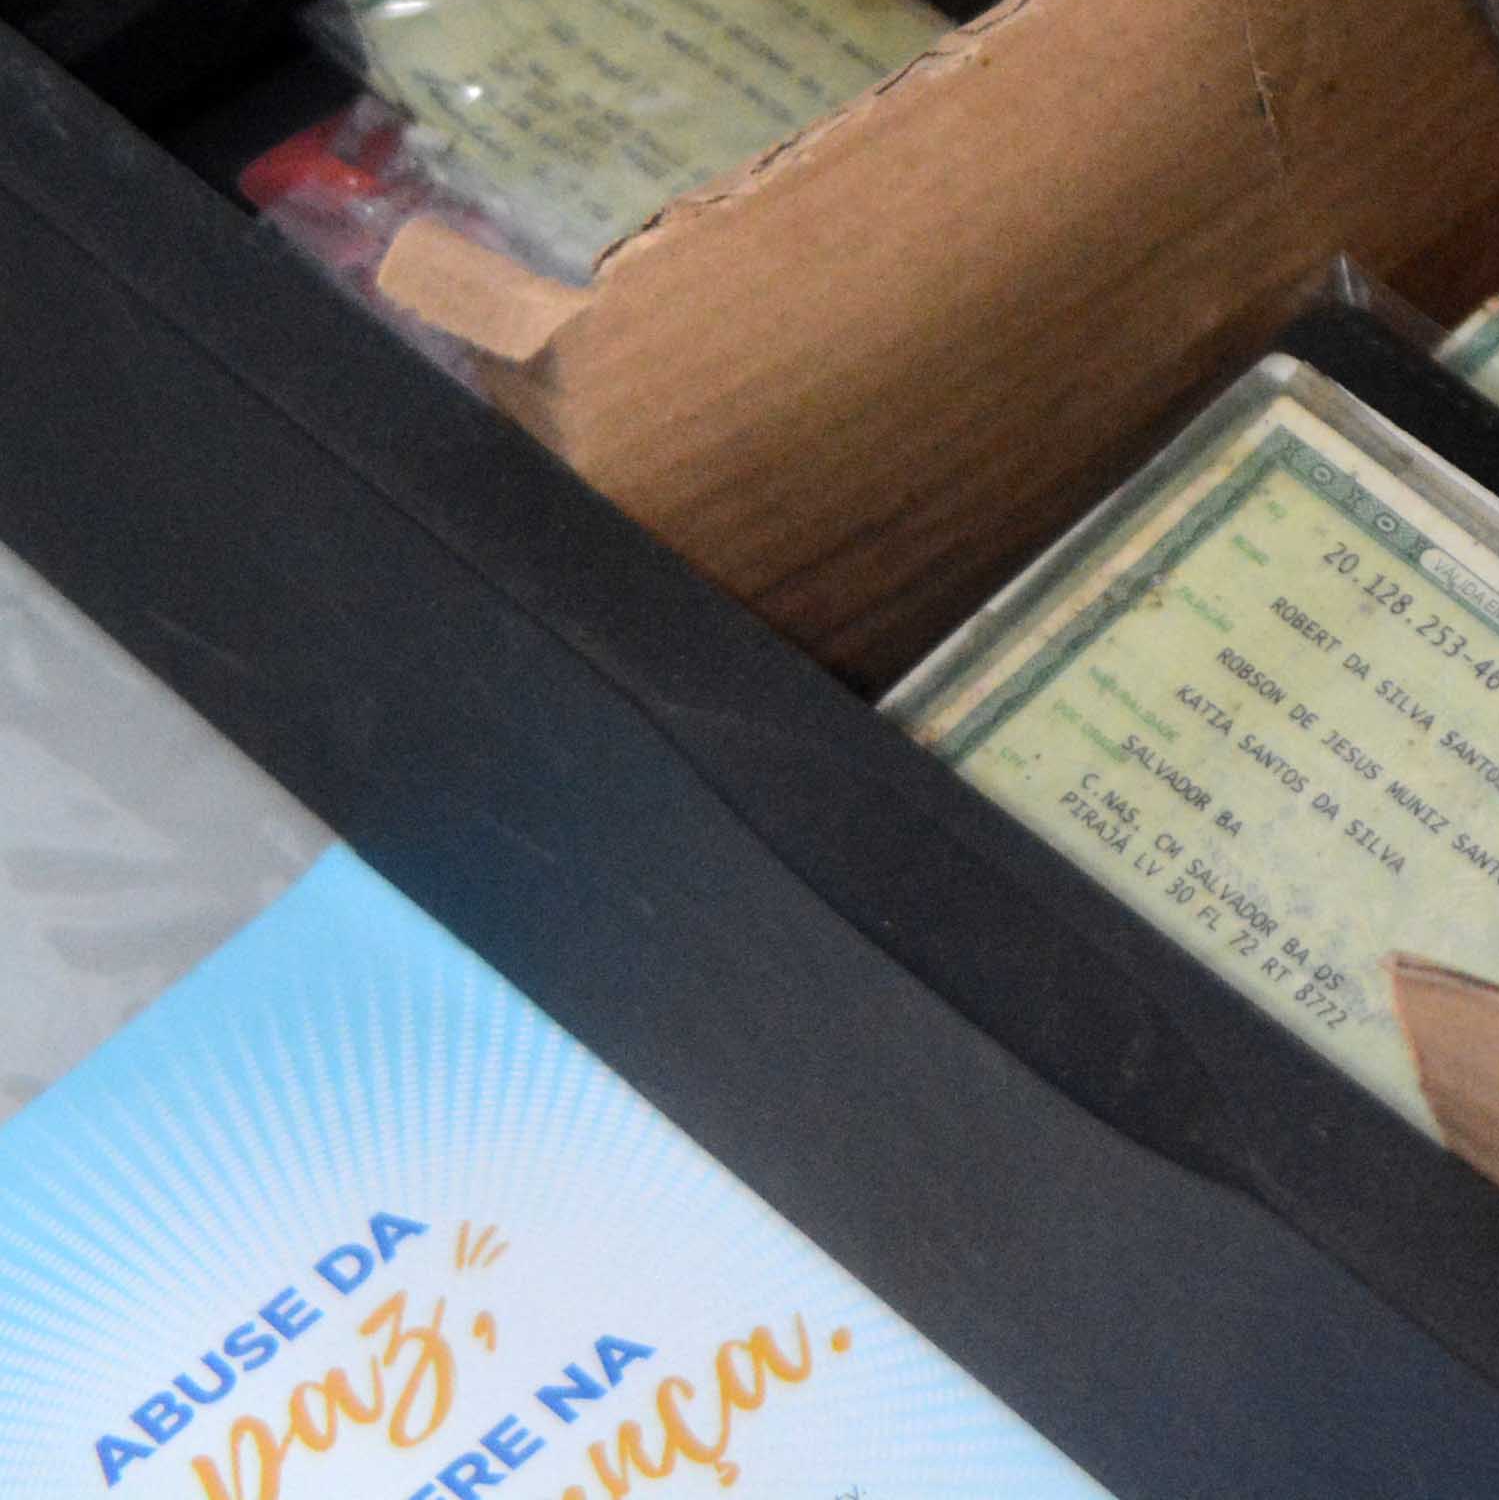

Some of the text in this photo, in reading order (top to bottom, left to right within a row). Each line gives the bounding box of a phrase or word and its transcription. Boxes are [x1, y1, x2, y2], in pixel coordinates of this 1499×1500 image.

[1210, 644, 1292, 708] ROBSON
[1283, 701, 1323, 734] DE
[1314, 726, 1390, 785] JESUS
[1378, 778, 1455, 837] MUNIZ
[1263, 594, 1346, 657] ROBERT
[1337, 649, 1379, 683] DA
[1368, 675, 1445, 734] SILVA
[1112, 731, 1249, 838] SALVADOR BA
[1169, 681, 1415, 875] KATIA SANTOS DA SILVA
[1128, 850, 1166, 881] LV
[1161, 874, 1202, 908] 30
[1191, 902, 1230, 934] FL
[1224, 926, 1265, 960] 72
[1256, 955, 1296, 987] RT
[1286, 979, 1355, 1033] 8772
[1148, 828, 1189, 861] CM
[1175, 855, 1288, 941] SALVADOR
[1277, 935, 1315, 967] BA
[93, 1210, 432, 1488] ABUSE DA
[533, 1332, 660, 1425] NA
